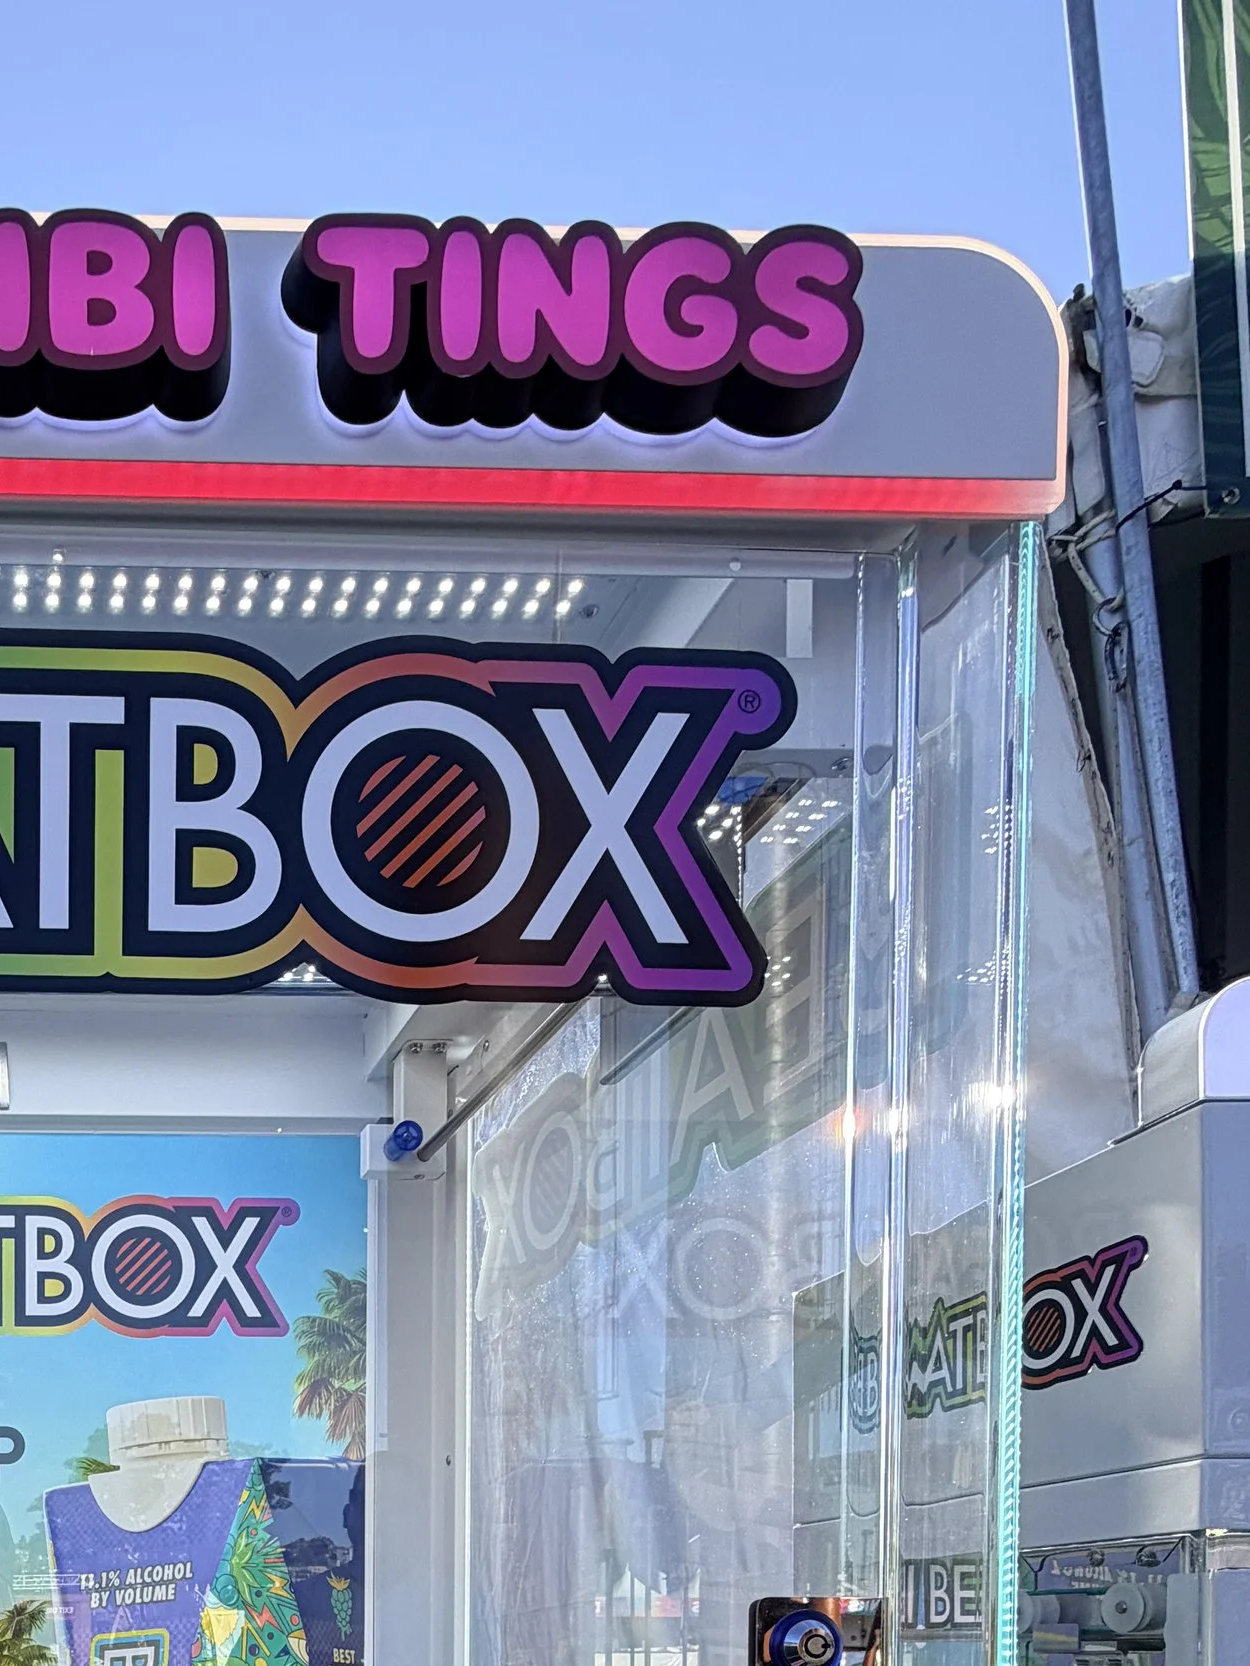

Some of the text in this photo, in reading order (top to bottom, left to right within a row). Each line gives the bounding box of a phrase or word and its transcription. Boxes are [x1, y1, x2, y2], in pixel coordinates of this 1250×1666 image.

[296, 213, 863, 412] TINGS
[125, 1561, 193, 1586] ALCOHOL
[90, 1583, 176, 1609] BY VOLUME
[333, 1647, 356, 1664] BEST
